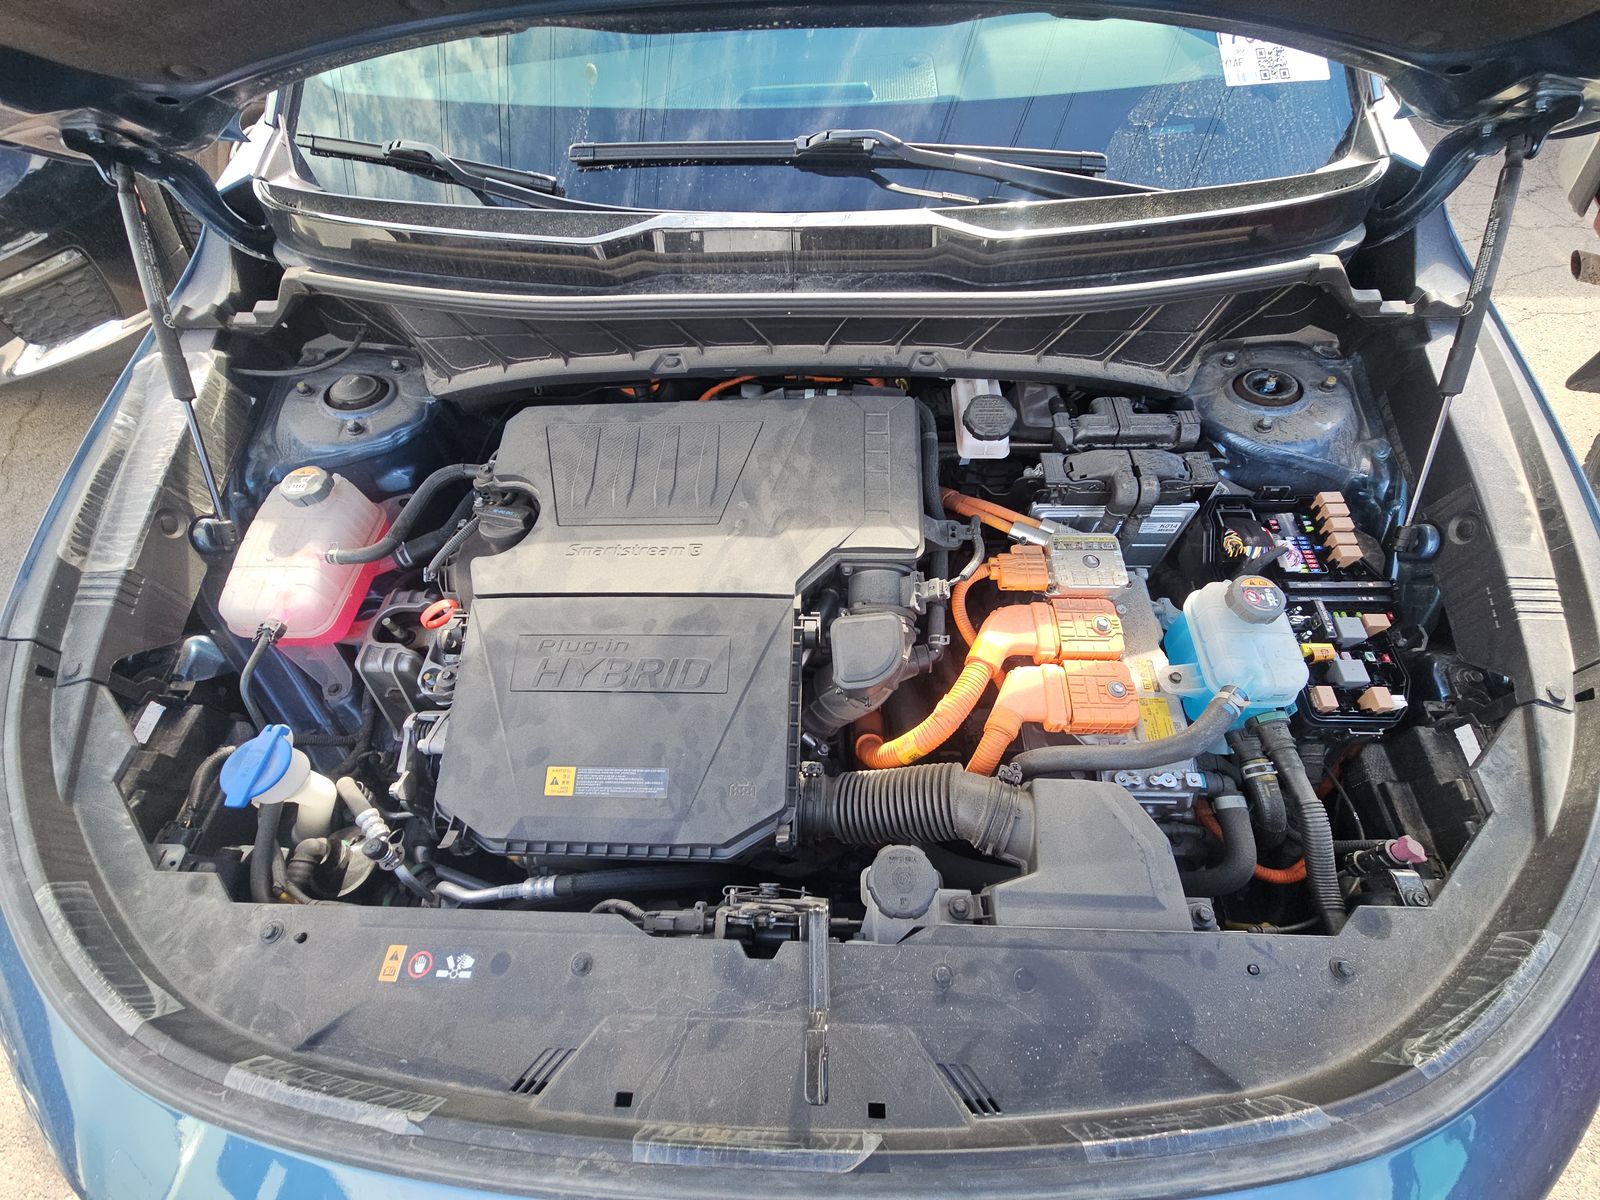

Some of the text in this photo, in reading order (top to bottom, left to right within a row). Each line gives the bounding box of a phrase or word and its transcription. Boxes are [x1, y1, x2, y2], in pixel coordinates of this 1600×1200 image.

[565, 543, 686, 557] Smartstream
[537, 638, 631, 656] Plug-in
[532, 657, 712, 690] HYBRID
